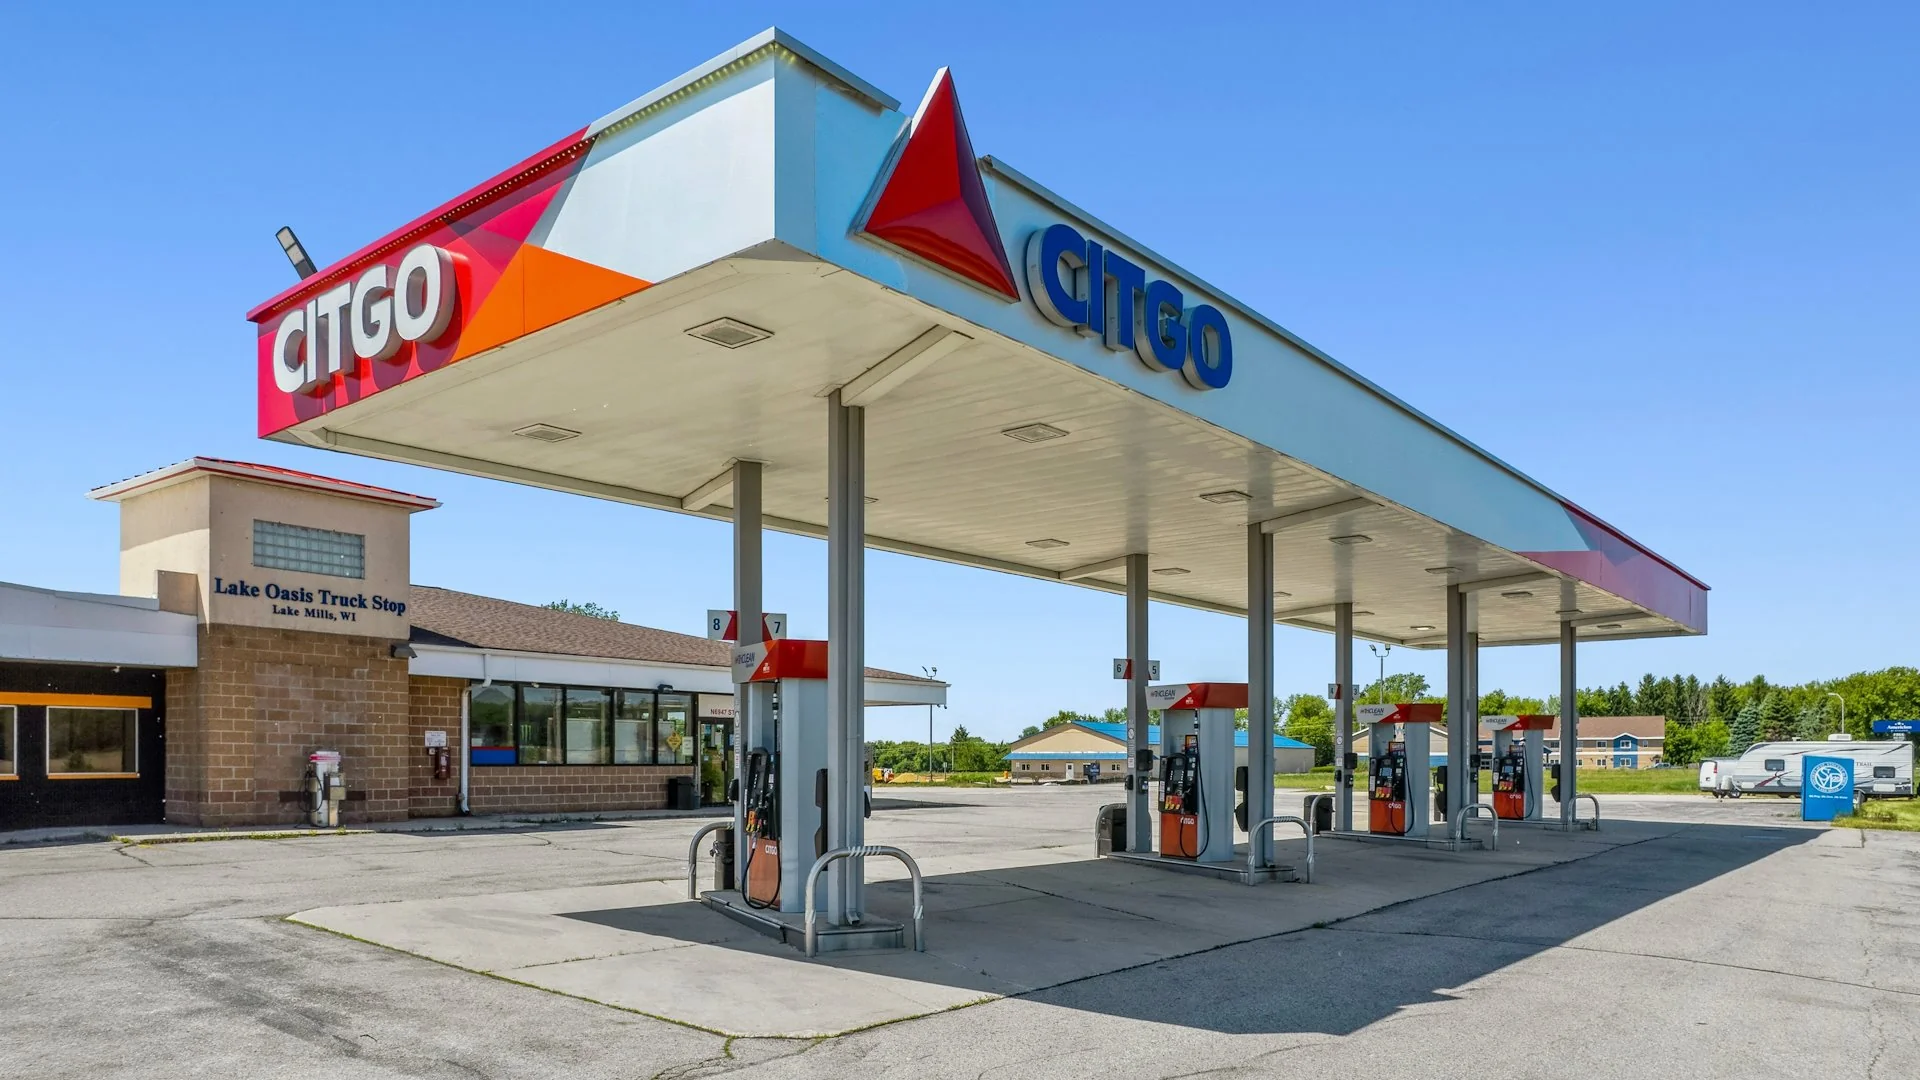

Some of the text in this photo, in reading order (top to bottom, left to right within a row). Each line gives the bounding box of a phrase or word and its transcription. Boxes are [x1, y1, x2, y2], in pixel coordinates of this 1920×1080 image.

[1034, 224, 1233, 389] CITGO
[273, 244, 446, 393] CITGO
[214, 578, 406, 616] Lake Oasis Truck Stop
[272, 604, 356, 622] Lake Mills, WI
[713, 618, 721, 631] 8
[774, 621, 781, 634] 7
[1116, 664, 1122, 673] 6
[1152, 665, 1157, 675] 5
[1353, 688, 1358, 696] 3
